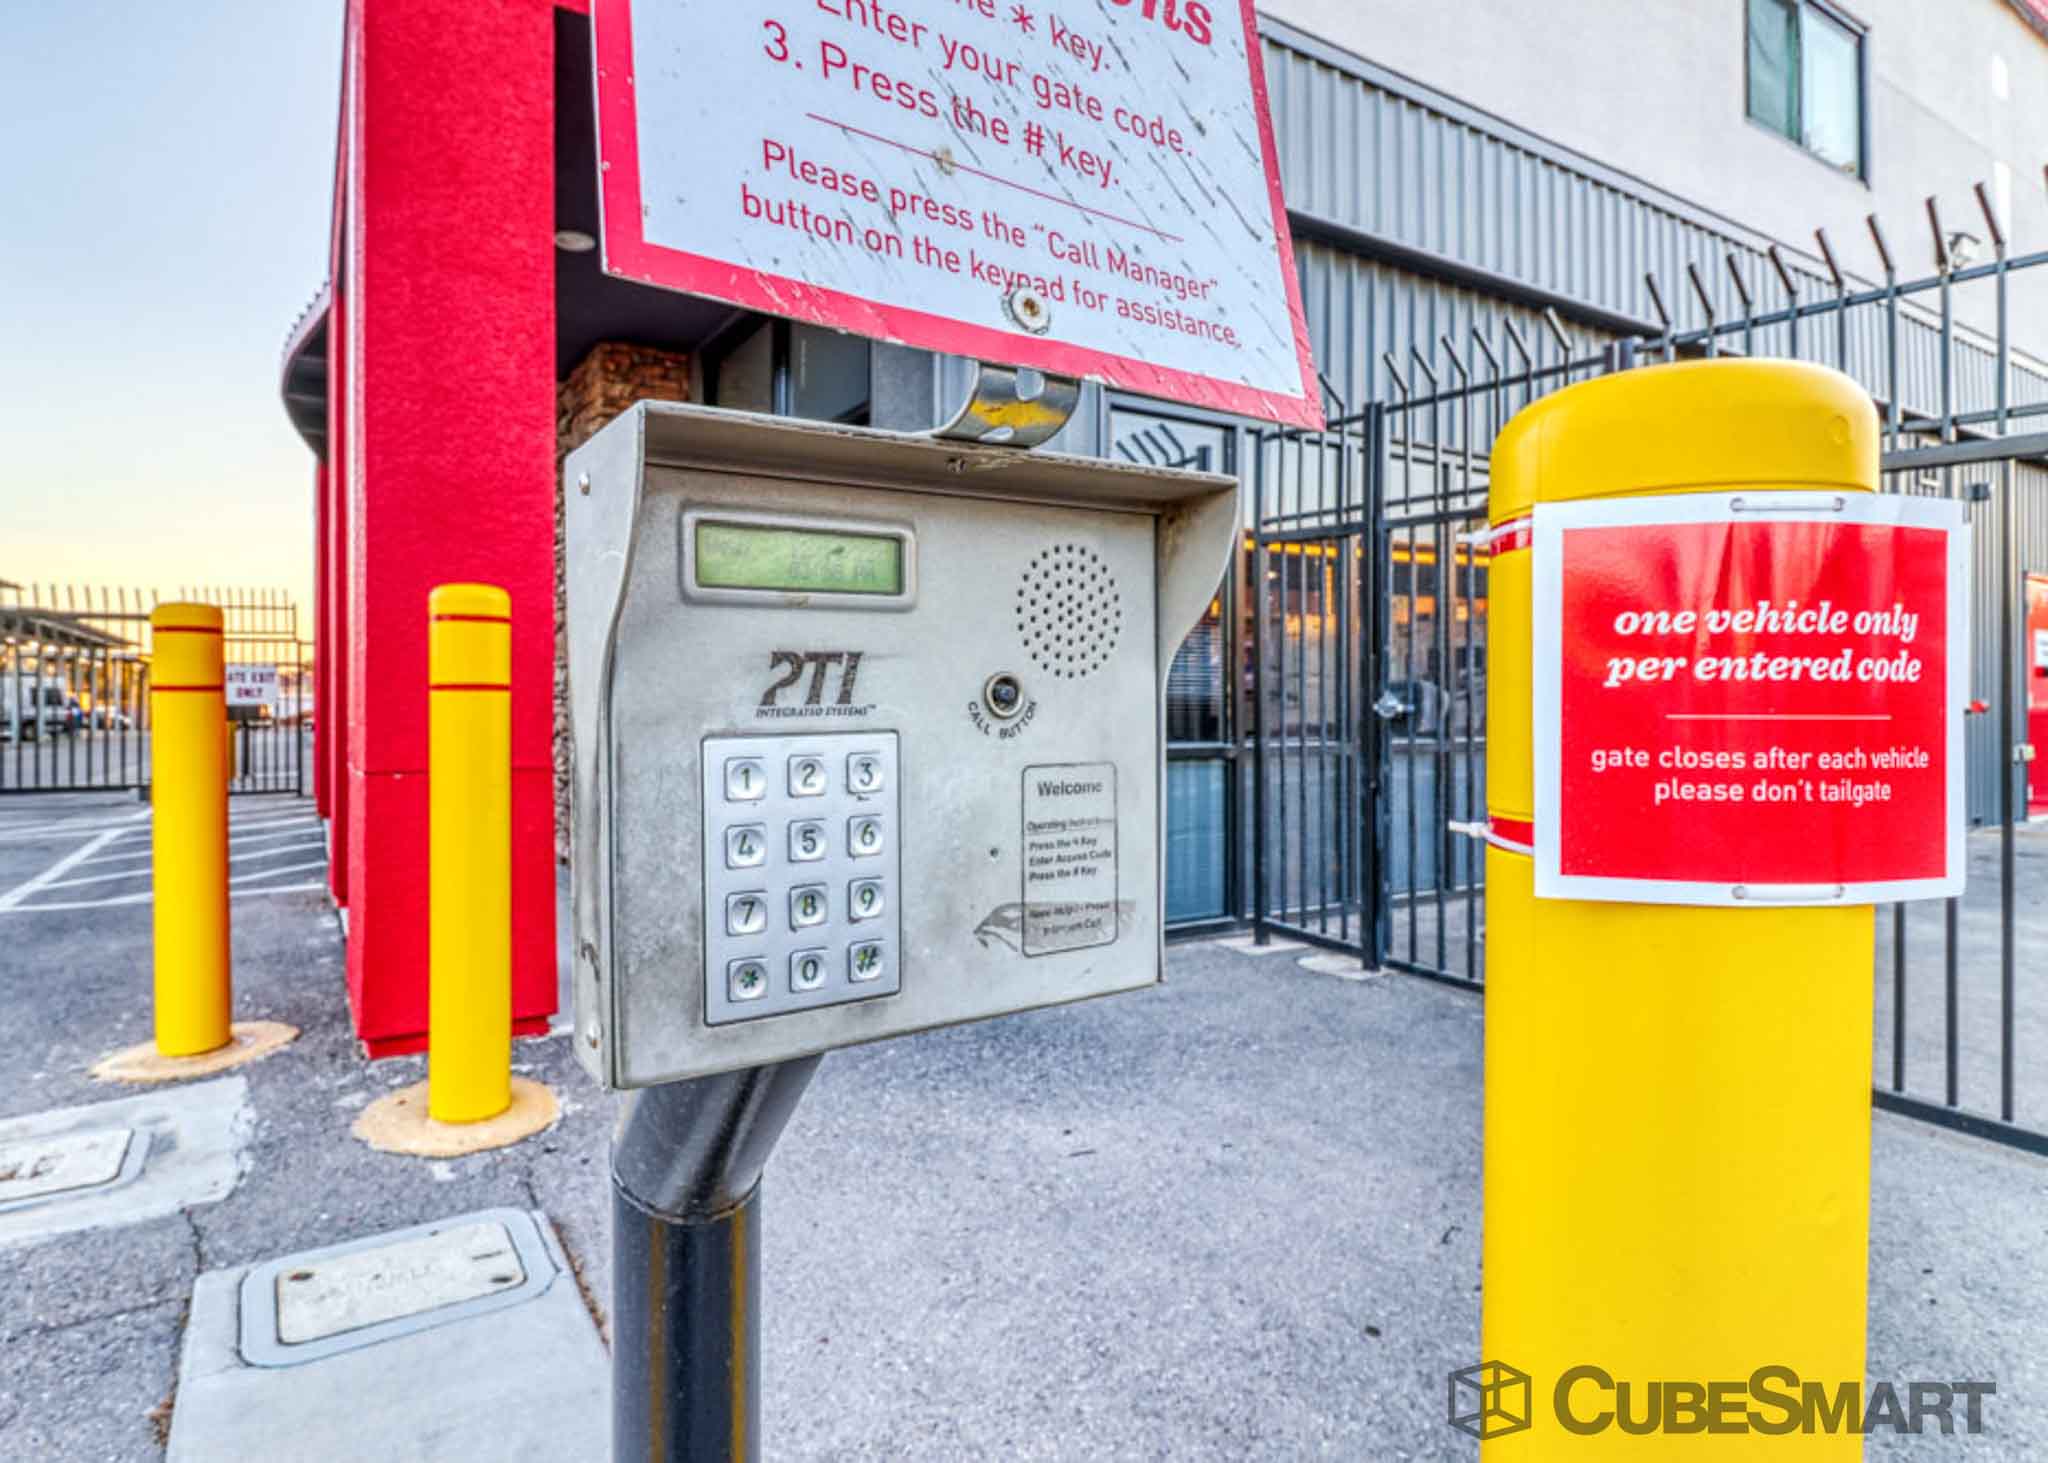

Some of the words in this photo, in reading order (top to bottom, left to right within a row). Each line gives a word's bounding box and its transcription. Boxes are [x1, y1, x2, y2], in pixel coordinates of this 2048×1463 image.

[1049, 13, 1110, 72] key.
[763, 19, 802, 70] 3.
[820, 40, 939, 119] Press
[950, 96, 1010, 145] the
[1023, 120, 1045, 156] #
[1057, 132, 1120, 188] key.
[938, 33, 1021, 86] your
[1032, 74, 1104, 121] gate
[1113, 107, 1196, 157] code.
[762, 138, 879, 203] Please
[889, 188, 974, 231] press
[982, 211, 1026, 248] the
[740, 182, 853, 245] button
[864, 228, 903, 259] on
[913, 234, 960, 273] the
[1072, 280, 1109, 312] for
[1116, 298, 1243, 349] assistance.
[1613, 609, 1696, 637] one
[1705, 600, 1847, 637] vehicle
[1852, 603, 1919, 642] only
[760, 651, 864, 705] PTI
[1603, 654, 1689, 689] per
[1694, 648, 1852, 683] entered
[1857, 649, 1921, 683] code
[968, 701, 990, 736] CALL
[999, 701, 1037, 739] BUTTON
[740, 767, 751, 791] 1
[801, 763, 817, 788] 2
[859, 762, 874, 787] 3
[1591, 747, 1650, 772] gate
[1658, 746, 1747, 770] closes
[1753, 746, 1813, 771] after
[1817, 746, 1867, 771] each
[1870, 746, 1930, 770] vehicle
[1037, 780, 1104, 797] Welcome
[1654, 779, 1745, 806] please
[1751, 779, 1814, 803] don't
[1819, 779, 1892, 808] tailgate
[738, 834, 755, 856] 4
[802, 829, 817, 854] 5
[861, 823, 876, 846] 6
[741, 900, 756, 926] 7
[802, 895, 818, 917] 8
[861, 887, 876, 911] 9
[802, 959, 818, 983] 0
